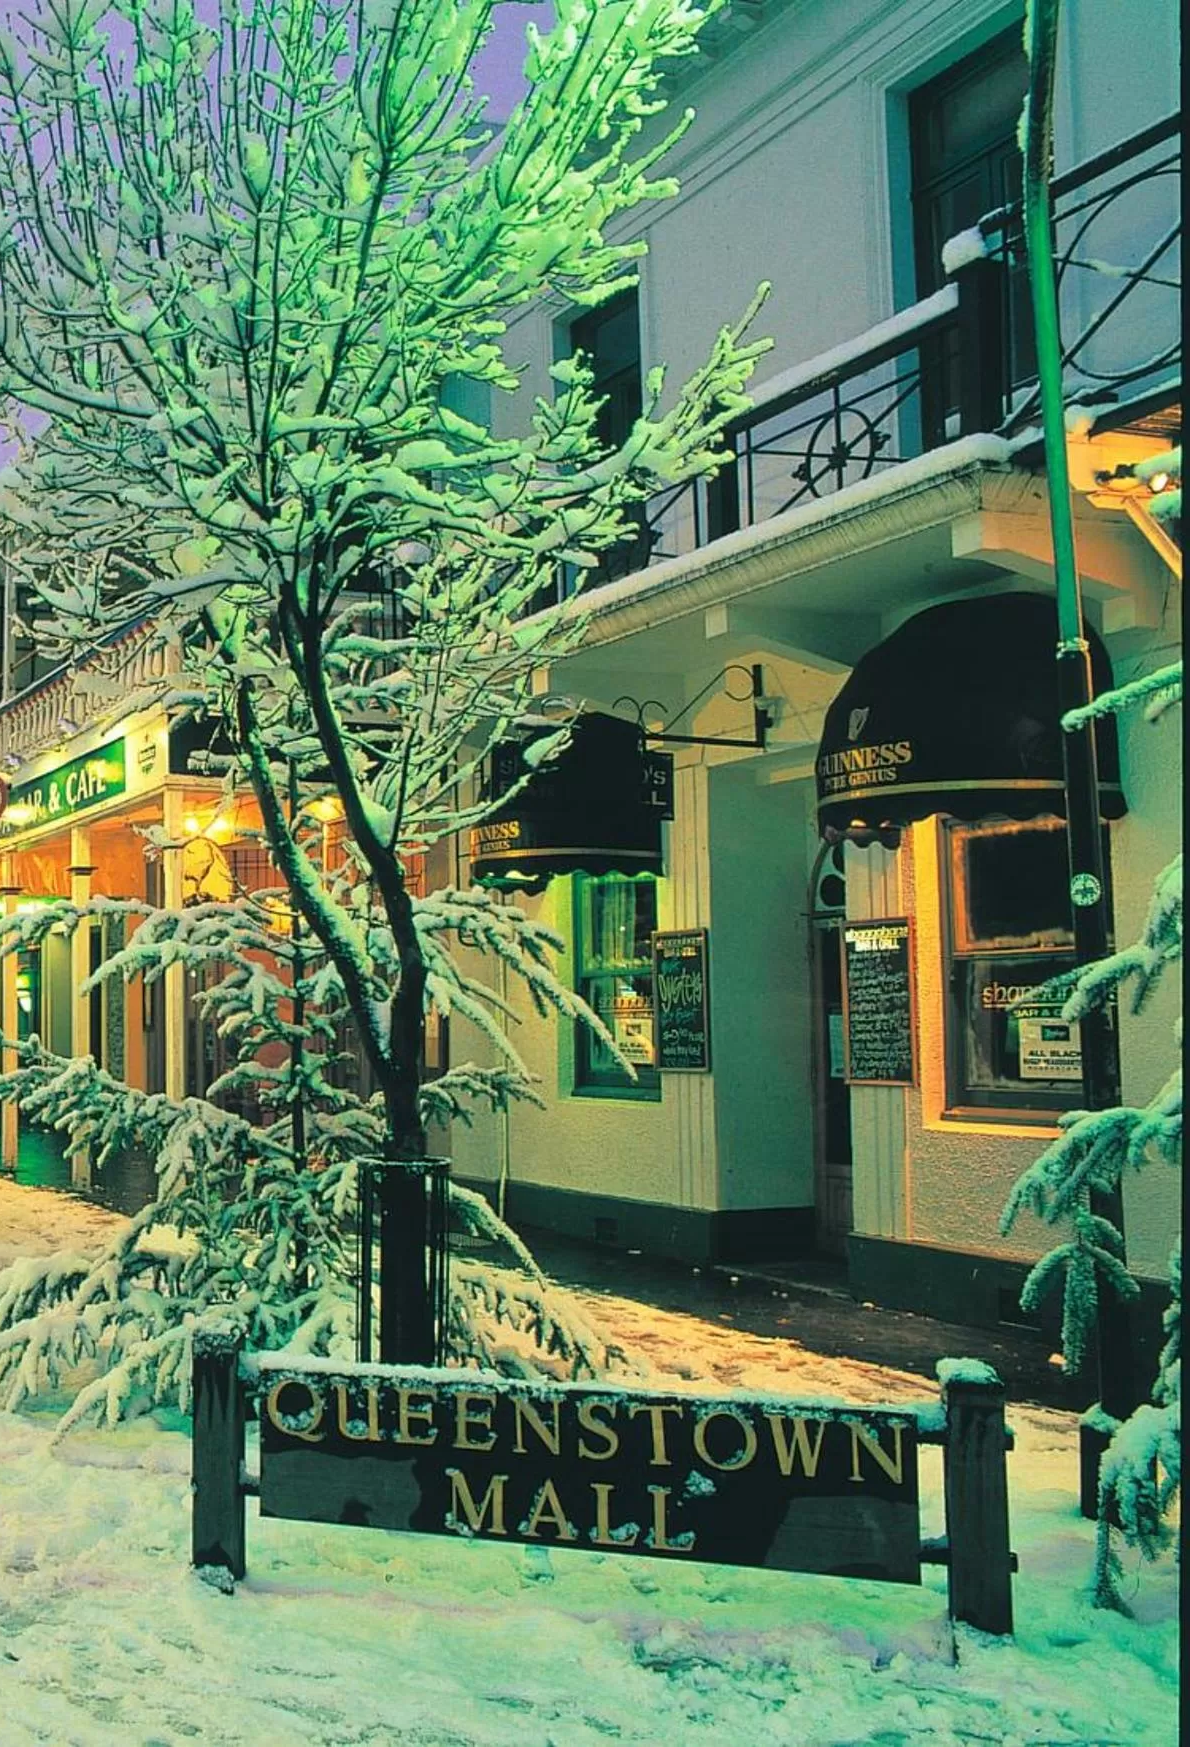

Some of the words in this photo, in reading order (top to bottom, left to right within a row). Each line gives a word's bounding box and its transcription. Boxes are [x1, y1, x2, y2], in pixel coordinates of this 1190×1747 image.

[819, 741, 913, 776] GUINNESS
[849, 767, 898, 787] GENIUS
[266, 1378, 905, 1484] QUEENSTOWN
[445, 1467, 697, 1552] MALL
